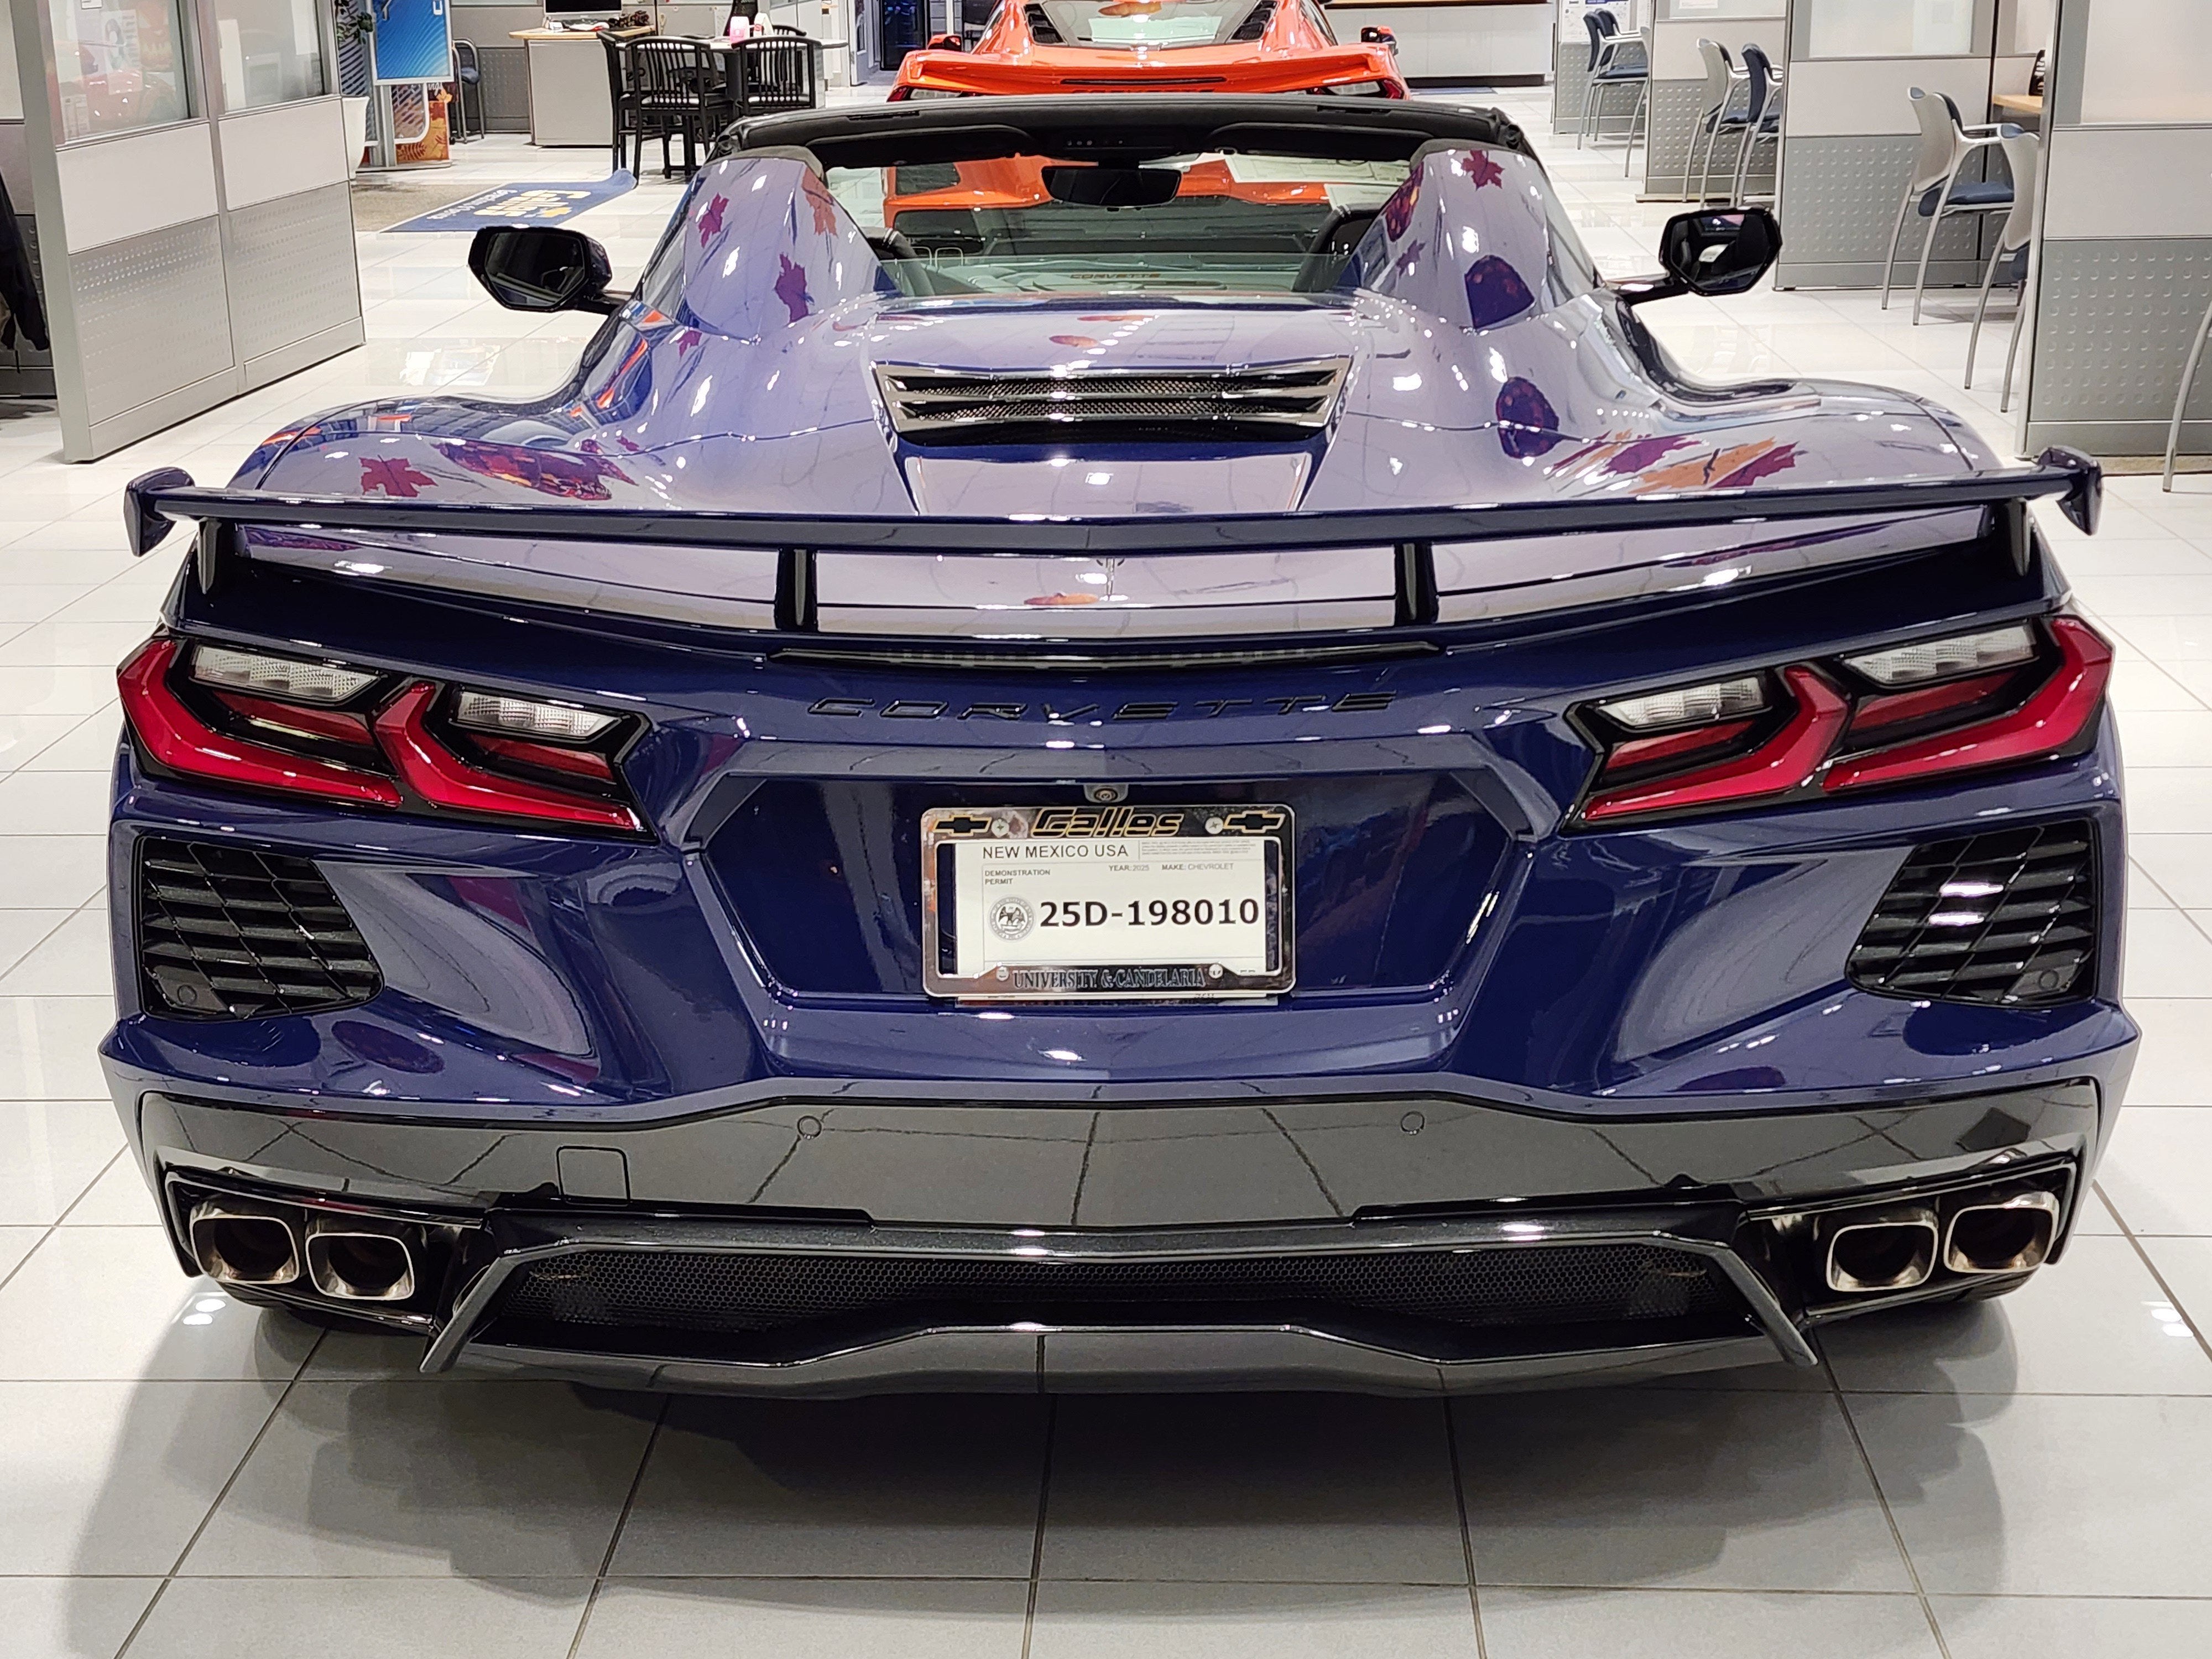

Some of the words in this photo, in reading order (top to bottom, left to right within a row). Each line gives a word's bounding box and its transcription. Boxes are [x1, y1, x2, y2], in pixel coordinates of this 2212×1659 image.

[807, 690, 1398, 721] CORVETTE
[1031, 806, 1185, 838] Galles
[983, 846, 1020, 859] NEW
[1025, 845, 1088, 858] MEXICO
[1094, 844, 1129, 857] USA
[1040, 899, 1259, 927] 25D-198010
[1013, 969, 1098, 989] UNIVERSITY
[1114, 968, 1207, 988] CANDELARIA
